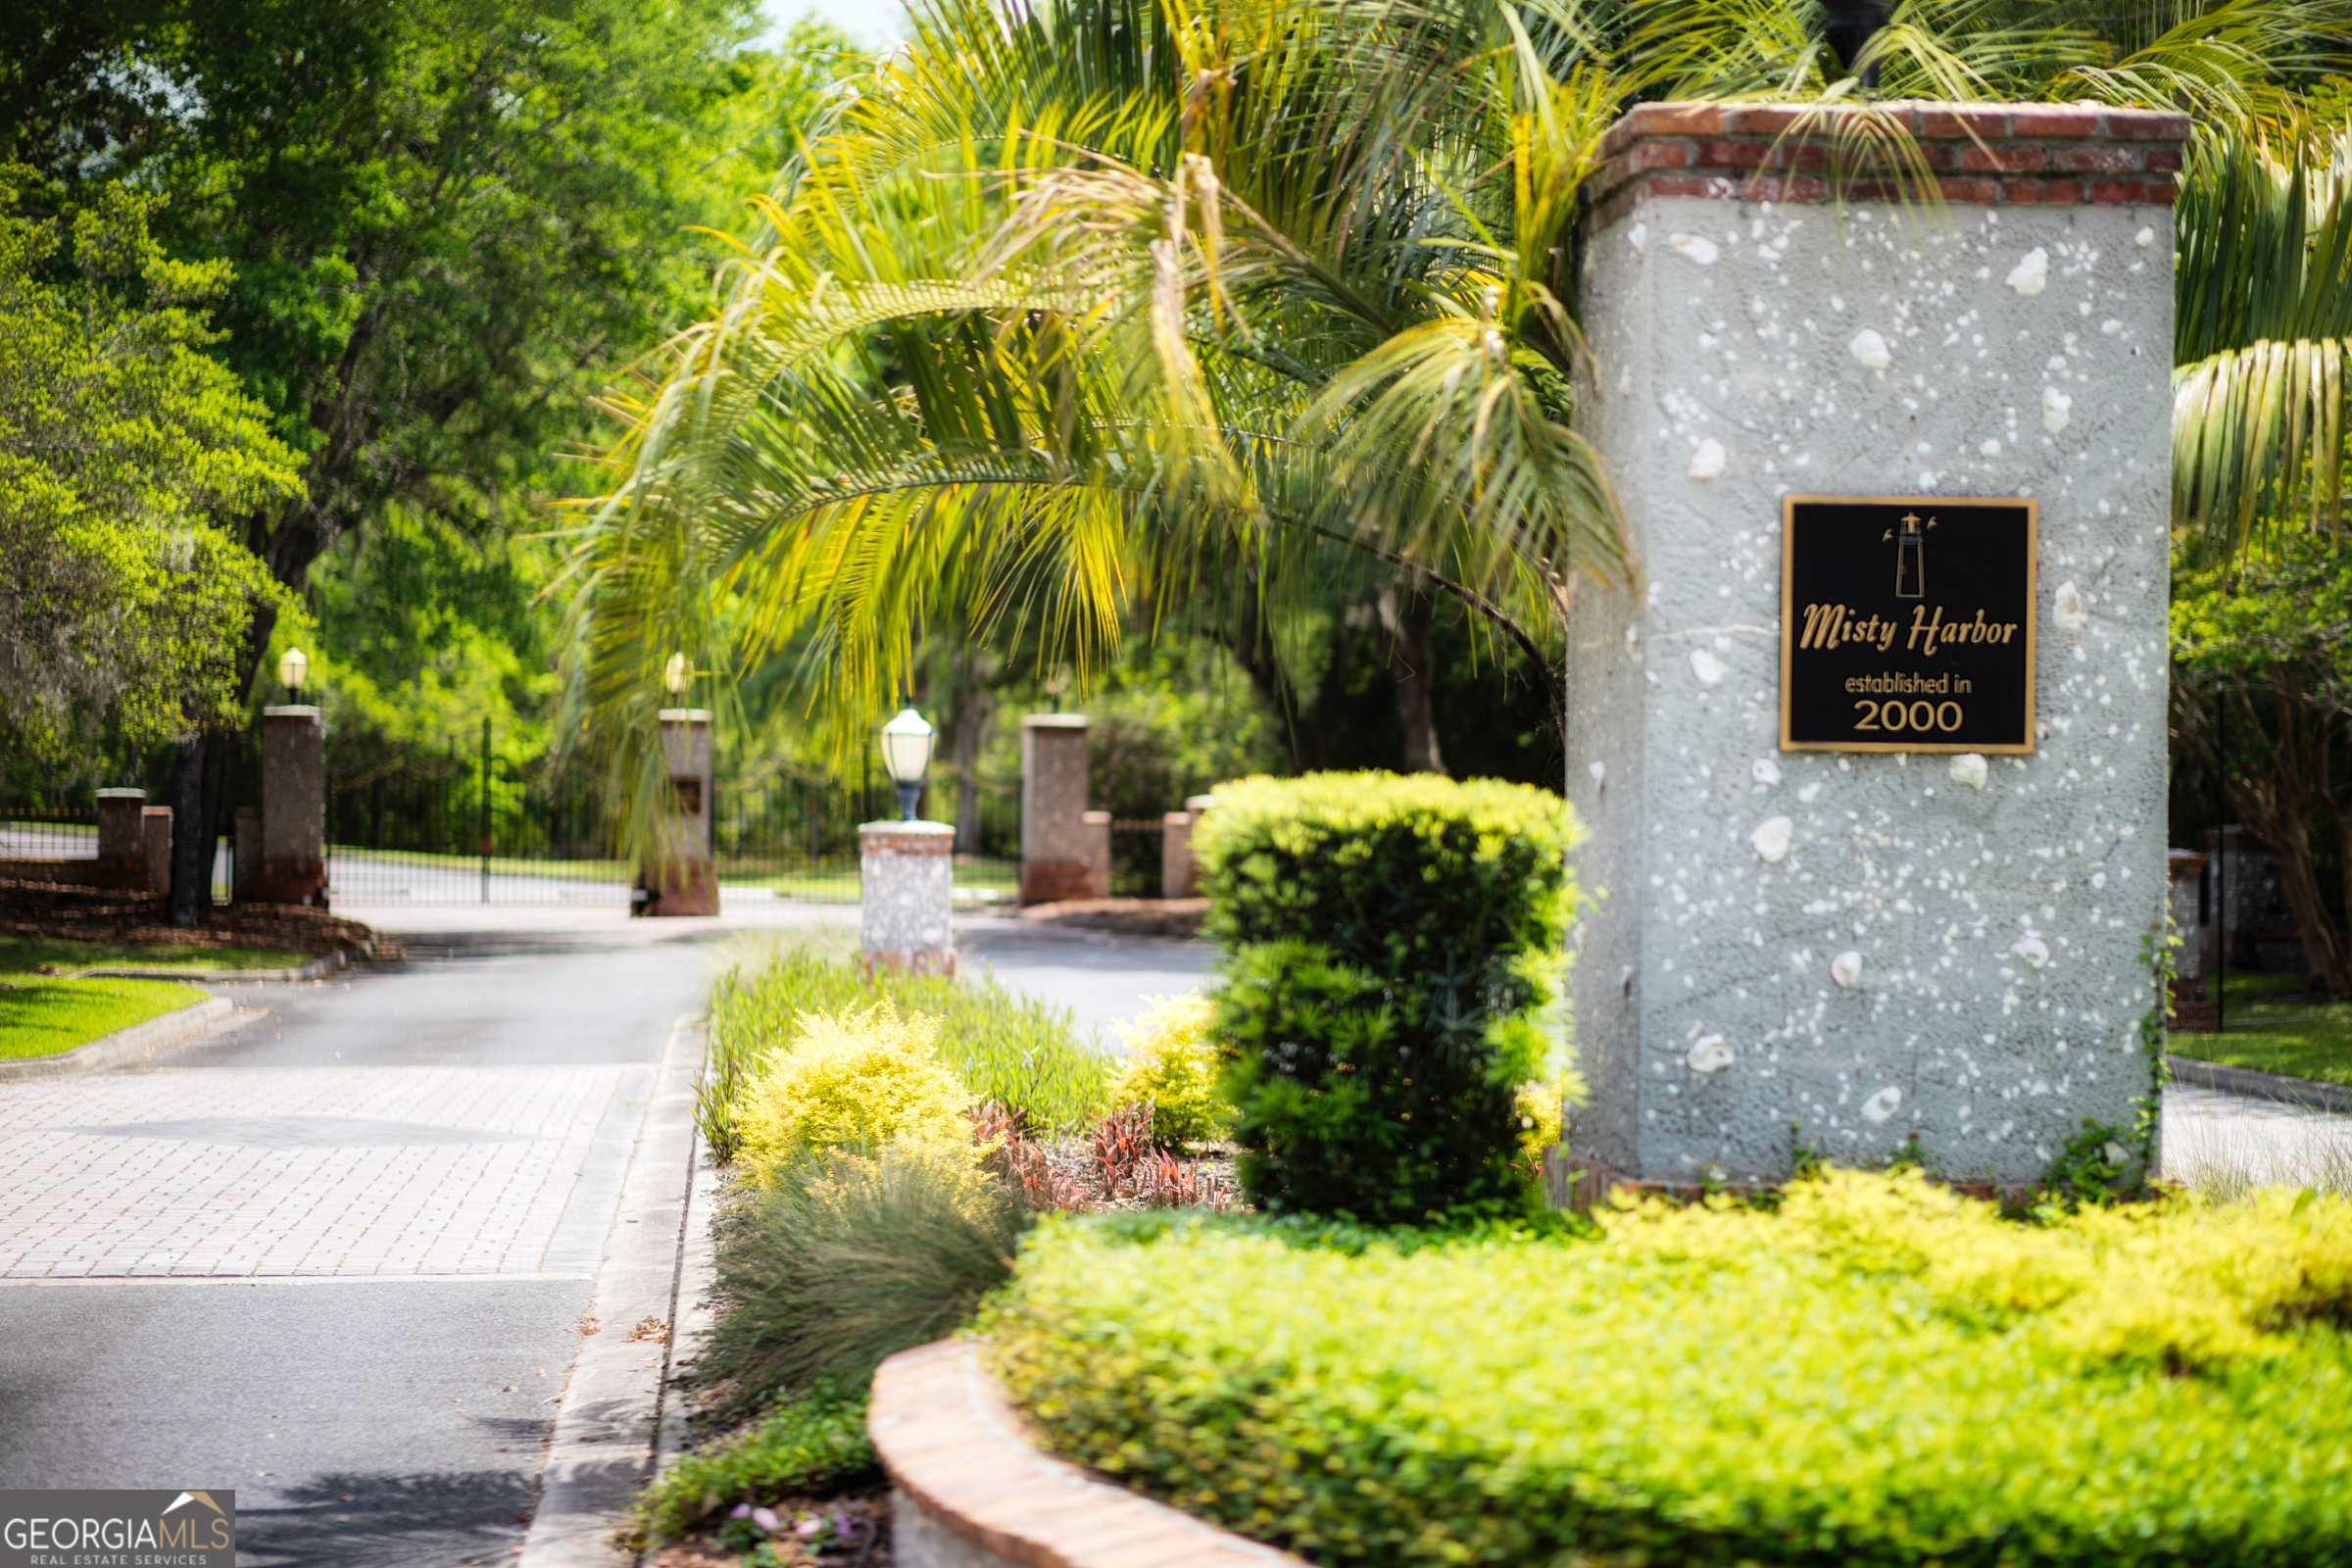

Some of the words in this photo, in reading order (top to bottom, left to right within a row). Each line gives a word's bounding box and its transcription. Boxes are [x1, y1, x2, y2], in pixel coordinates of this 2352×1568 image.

[1799, 603, 1898, 651] Misty
[1906, 604, 2018, 656] Harbor
[1844, 671, 1948, 694] established
[1954, 673, 1972, 694] in
[1853, 700, 1964, 731] 2000
